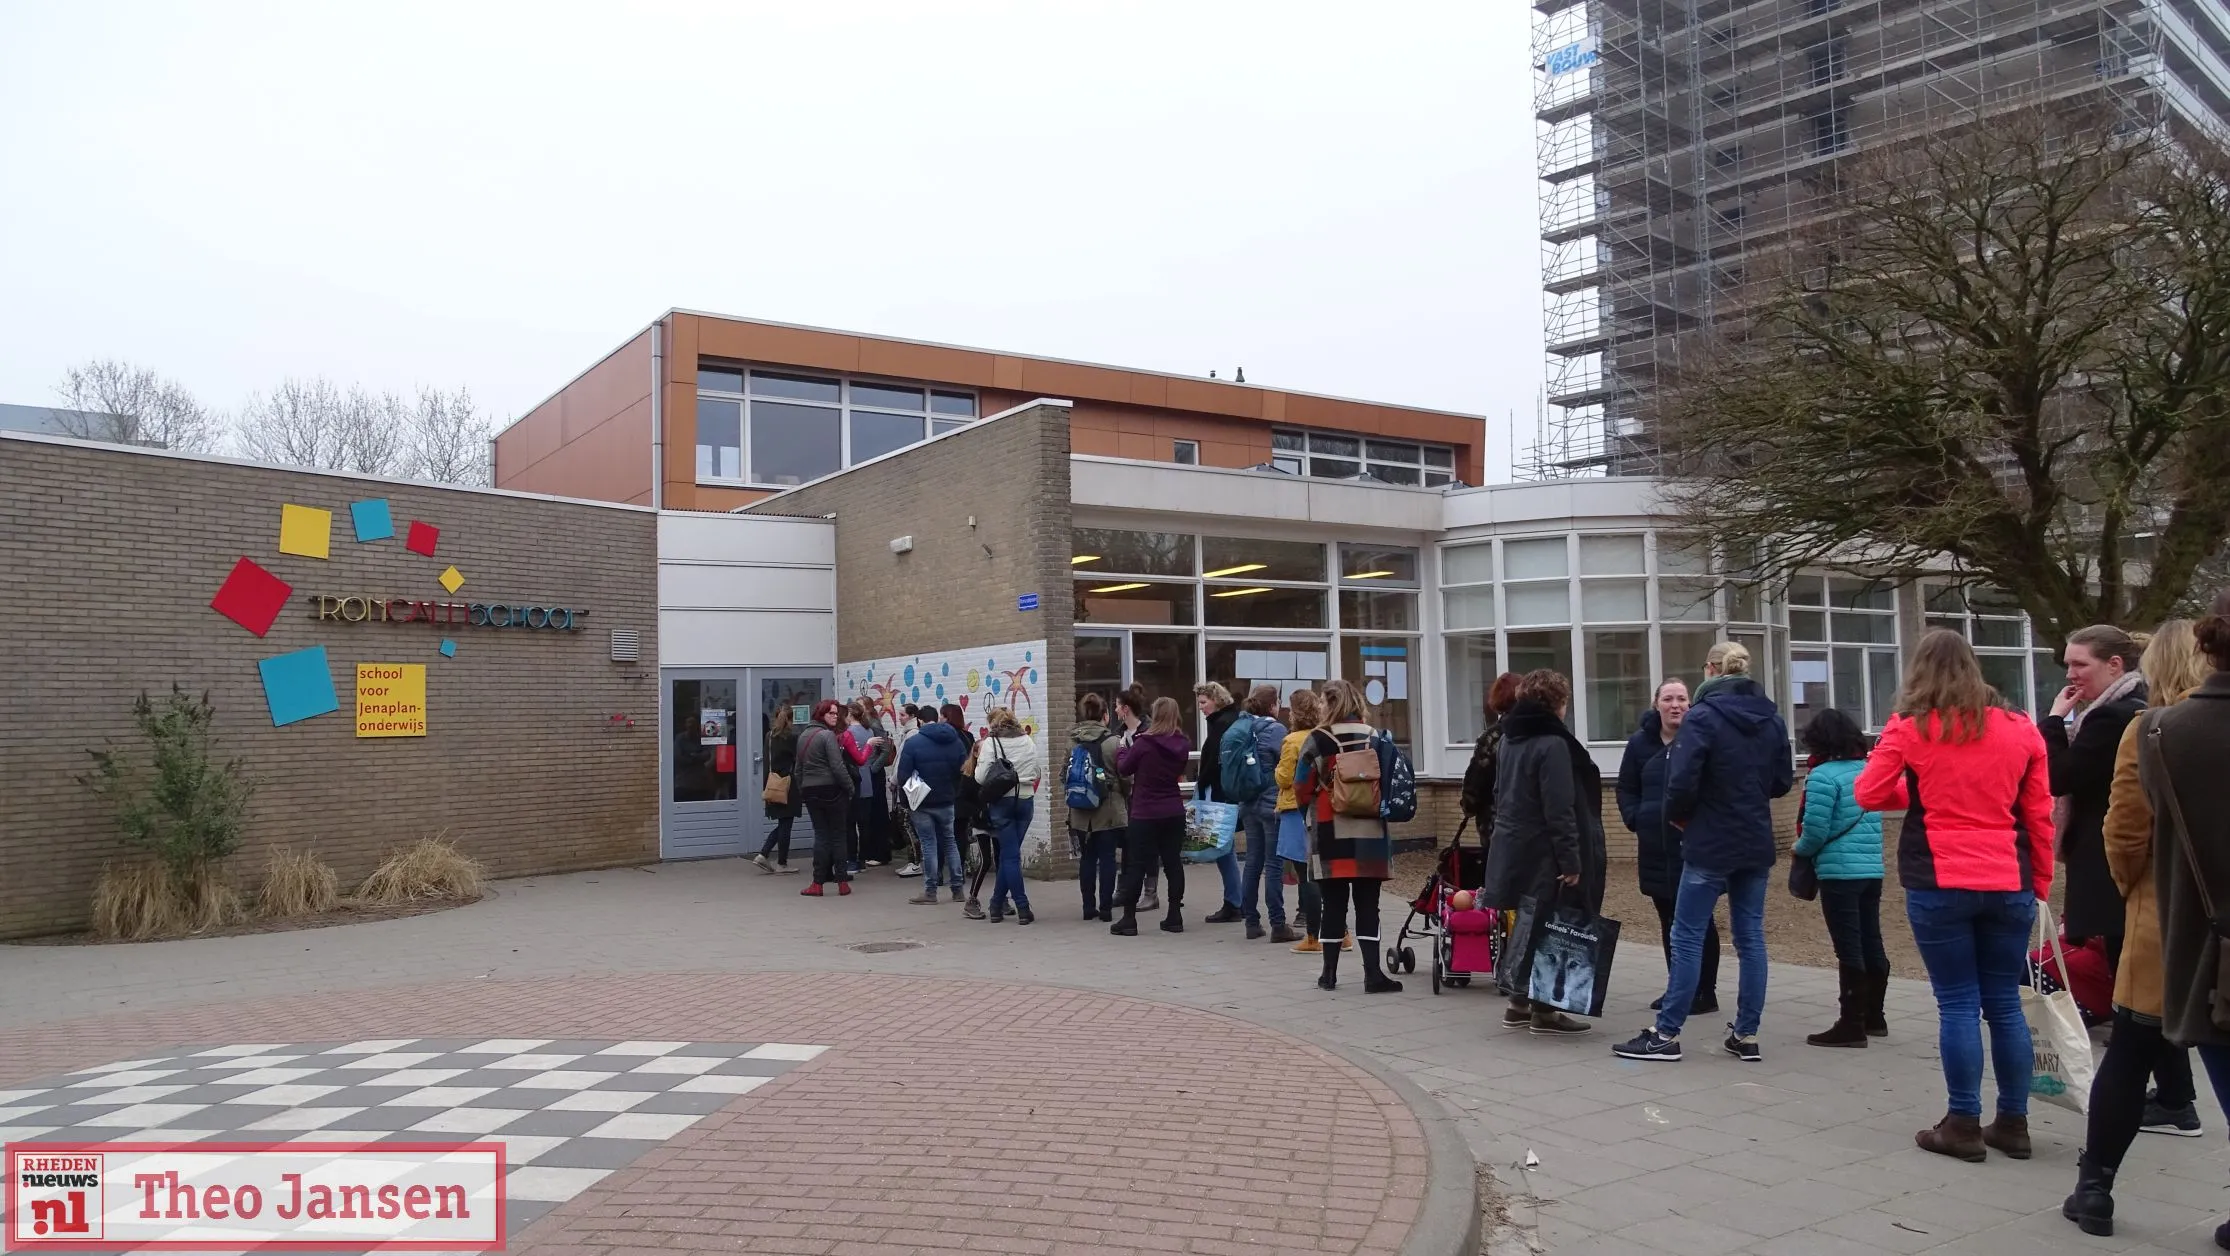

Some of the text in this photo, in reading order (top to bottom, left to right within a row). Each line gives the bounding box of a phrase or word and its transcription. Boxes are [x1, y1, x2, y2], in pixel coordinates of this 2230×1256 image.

[1546, 43, 1580, 66] VAST
[1551, 50, 1597, 75] BOUW
[359, 666, 403, 680] school
[359, 687, 390, 697] voor
[359, 700, 422, 717] Jenaplan-
[359, 718, 424, 734] onderwijs
